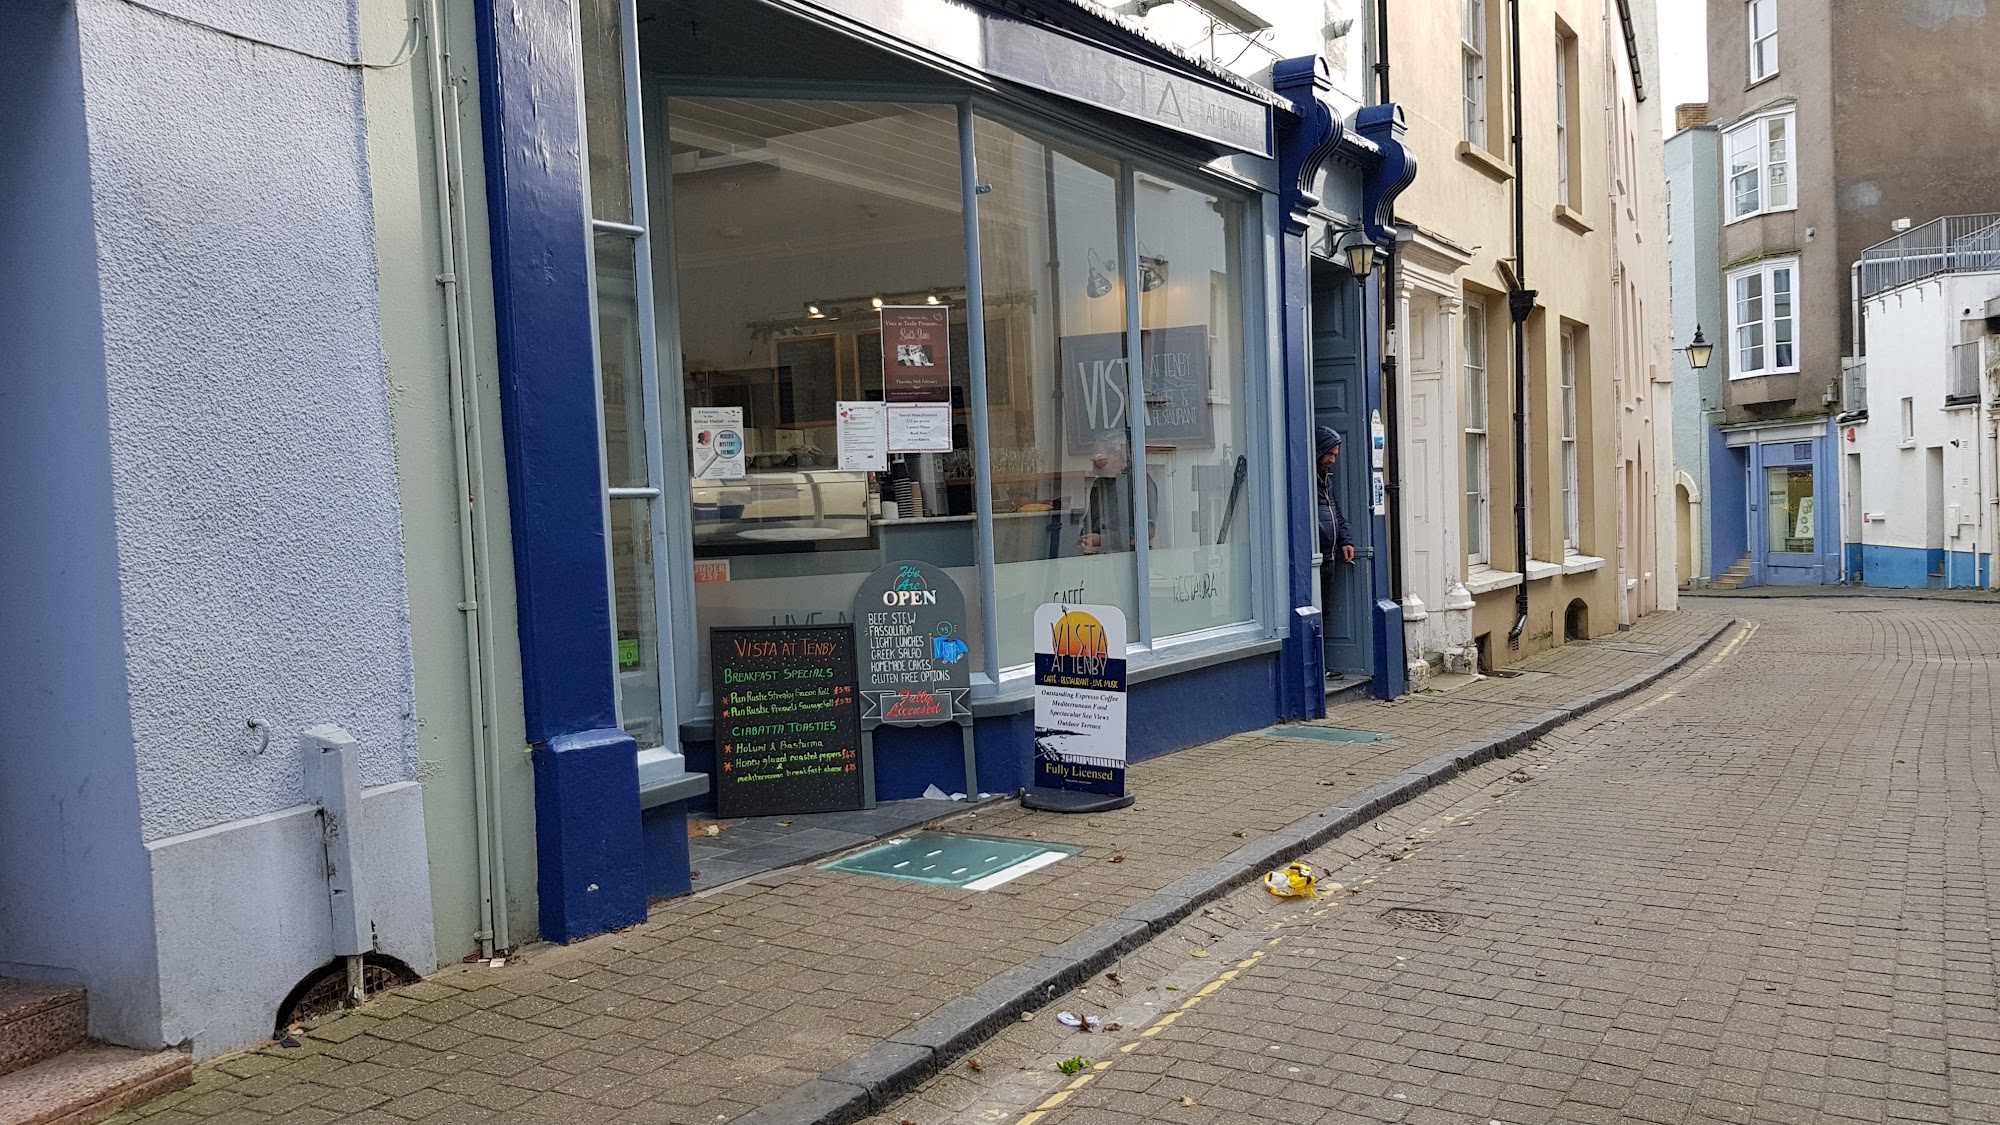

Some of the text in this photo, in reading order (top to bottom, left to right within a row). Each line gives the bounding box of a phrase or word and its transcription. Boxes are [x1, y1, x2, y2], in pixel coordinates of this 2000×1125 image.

[1163, 352, 1191, 378] TENBY
[882, 590, 937, 606] OPEN
[868, 611, 917, 625] BEEF STEW
[870, 636, 925, 649] LIGHT LUNCHES
[1050, 622, 1109, 657] VISTA
[782, 642, 797, 657] AT
[871, 648, 922, 660] GREEK SALAD
[871, 660, 907, 672] HOMEMADE
[908, 659, 932, 671] CAKES
[1051, 653, 1108, 677] AT TENBY
[871, 670, 951, 684] GLUTEN FREE OPTIONS
[1060, 675, 1089, 687] RESTAURANT
[746, 690, 768, 702] Rustic
[899, 689, 934, 706] Fully
[1041, 689, 1119, 703] Outstanding Espresso Coffee
[746, 703, 769, 716] Rustic
[887, 701, 943, 718] Licensed
[1051, 699, 1092, 709] Mediterranean
[1049, 709, 1081, 718] Spectacular
[732, 720, 837, 737] CIABATTA TOASTIES
[1057, 719, 1102, 730] Outdoor Terrace
[736, 757, 761, 772] Honey
[789, 751, 818, 762] roasted
[1045, 762, 1114, 781] Fully Licensed
